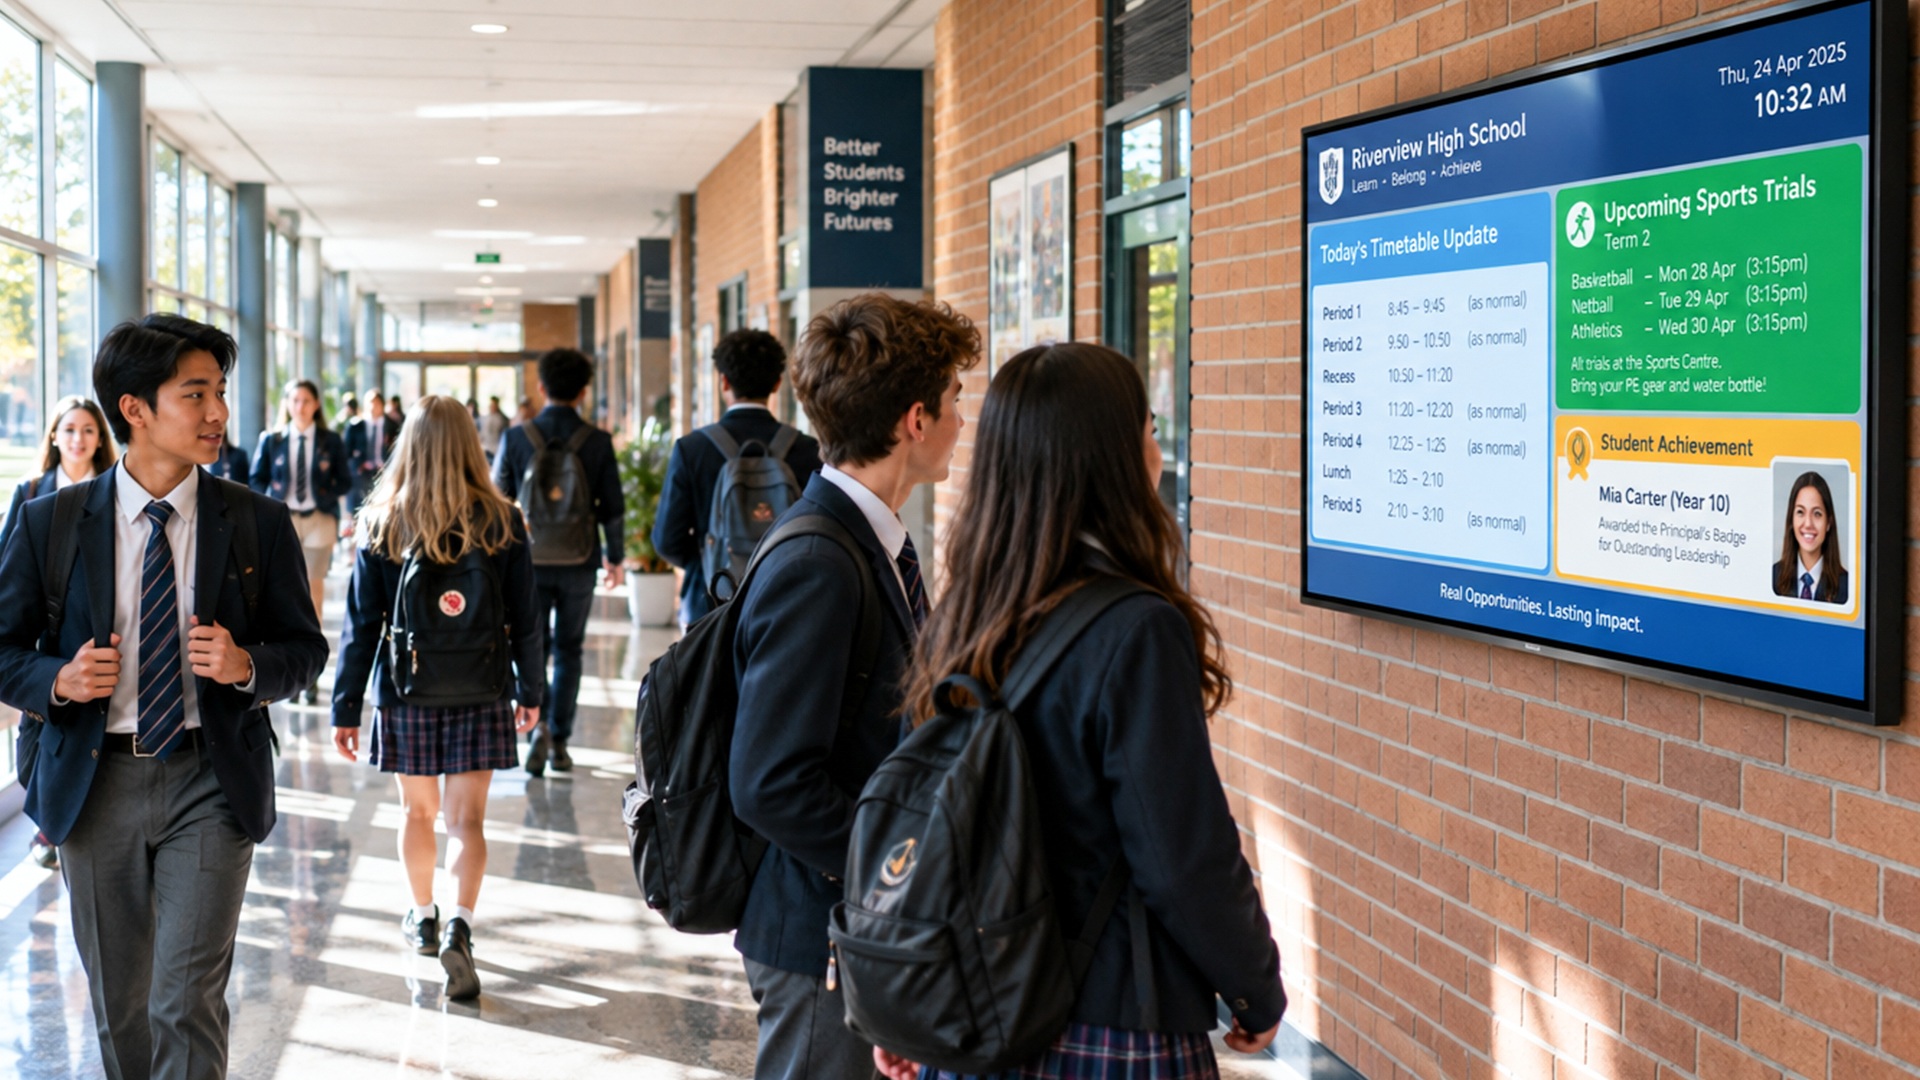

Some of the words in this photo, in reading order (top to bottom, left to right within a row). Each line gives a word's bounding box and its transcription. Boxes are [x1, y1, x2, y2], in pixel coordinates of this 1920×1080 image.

[1718, 66, 1750, 86] Thu,
[1753, 58, 1772, 79] 24
[1776, 55, 1804, 77] Apr
[1808, 41, 1847, 67] 2025
[1754, 82, 1813, 118] 10:32
[1817, 83, 1847, 107] AM
[824, 137, 881, 156] Better
[1352, 139, 1423, 170] Riverview
[1428, 128, 1464, 157] High
[1469, 112, 1526, 147] School
[824, 162, 905, 181] Students
[1352, 178, 1378, 194] Learn
[1392, 170, 1427, 186] Belong
[1440, 159, 1482, 178] Achieve
[824, 187, 898, 211] Brighter
[1604, 193, 1691, 226] Upcoming
[1696, 184, 1758, 215] Sports
[1763, 174, 1816, 202] Trials
[824, 212, 893, 231] Futures
[1320, 240, 1367, 265] Today's
[1370, 231, 1440, 258] Timetable
[1443, 224, 1498, 253] Update
[1604, 232, 1638, 250] Term
[1642, 229, 1651, 247] 2
[1571, 268, 1633, 290] Basketball
[1659, 266, 1687, 283] Mon
[1691, 263, 1708, 280] 28
[1711, 261, 1736, 282] Apr
[1746, 253, 1808, 278] (3:15pm)
[1322, 304, 1353, 321] Period
[1356, 304, 1362, 319] 1
[1468, 294, 1484, 312] (as
[1486, 290, 1527, 309] normal)
[1571, 296, 1614, 314] Netball
[1659, 291, 1681, 309] Tue
[1685, 290, 1701, 308] 29
[1705, 289, 1729, 310] Apr
[1746, 282, 1808, 307] (3:15pm)
[1571, 322, 1623, 339] Athletics
[1659, 318, 1688, 336] Wed
[1691, 317, 1708, 334] 30
[1711, 316, 1736, 337] Apr
[1746, 312, 1808, 335] (3:15pm)
[1322, 336, 1353, 353] Period
[1356, 336, 1362, 352] 2
[1467, 330, 1484, 348] (as
[1486, 328, 1527, 347] normal)
[1322, 369, 1356, 384] Recess
[1585, 355, 1611, 371] trials
[1612, 357, 1623, 371] at
[1626, 354, 1643, 370] the
[1646, 354, 1680, 373] Sports
[1682, 353, 1722, 370] Centre.
[1571, 377, 1597, 397] Bring
[1599, 381, 1624, 397] your
[1626, 377, 1640, 393] PE
[1642, 380, 1667, 397] gear
[1669, 377, 1690, 393] and
[1693, 379, 1725, 393] water
[1728, 376, 1767, 393] bottle!
[1322, 401, 1353, 416] Period
[1356, 401, 1362, 416] 3
[1467, 402, 1484, 421] (as
[1486, 401, 1527, 422] normal)
[1322, 432, 1353, 448] Period
[1356, 433, 1362, 448] 4
[1467, 438, 1484, 456] (as
[1486, 439, 1527, 460] normal)
[1600, 433, 1654, 453] Student
[1658, 435, 1754, 457] Achievement
[1322, 464, 1351, 480] Lunch
[1322, 494, 1353, 513] Period
[1356, 499, 1362, 514] 5
[1467, 511, 1483, 529] (as
[1486, 513, 1527, 534] normal)
[1599, 486, 1622, 504] Mia
[1625, 488, 1667, 508] Carter
[1670, 491, 1706, 512] (Year
[1710, 494, 1730, 515] 10)
[1598, 517, 1640, 534] Awarded
[1642, 522, 1658, 535] the
[1713, 528, 1747, 548] Badge
[1598, 537, 1612, 551] for
[1675, 547, 1730, 569] Leadership
[1440, 582, 1463, 601] Real
[1465, 587, 1546, 616] Opportunities.
[1548, 601, 1592, 629] Lasting
